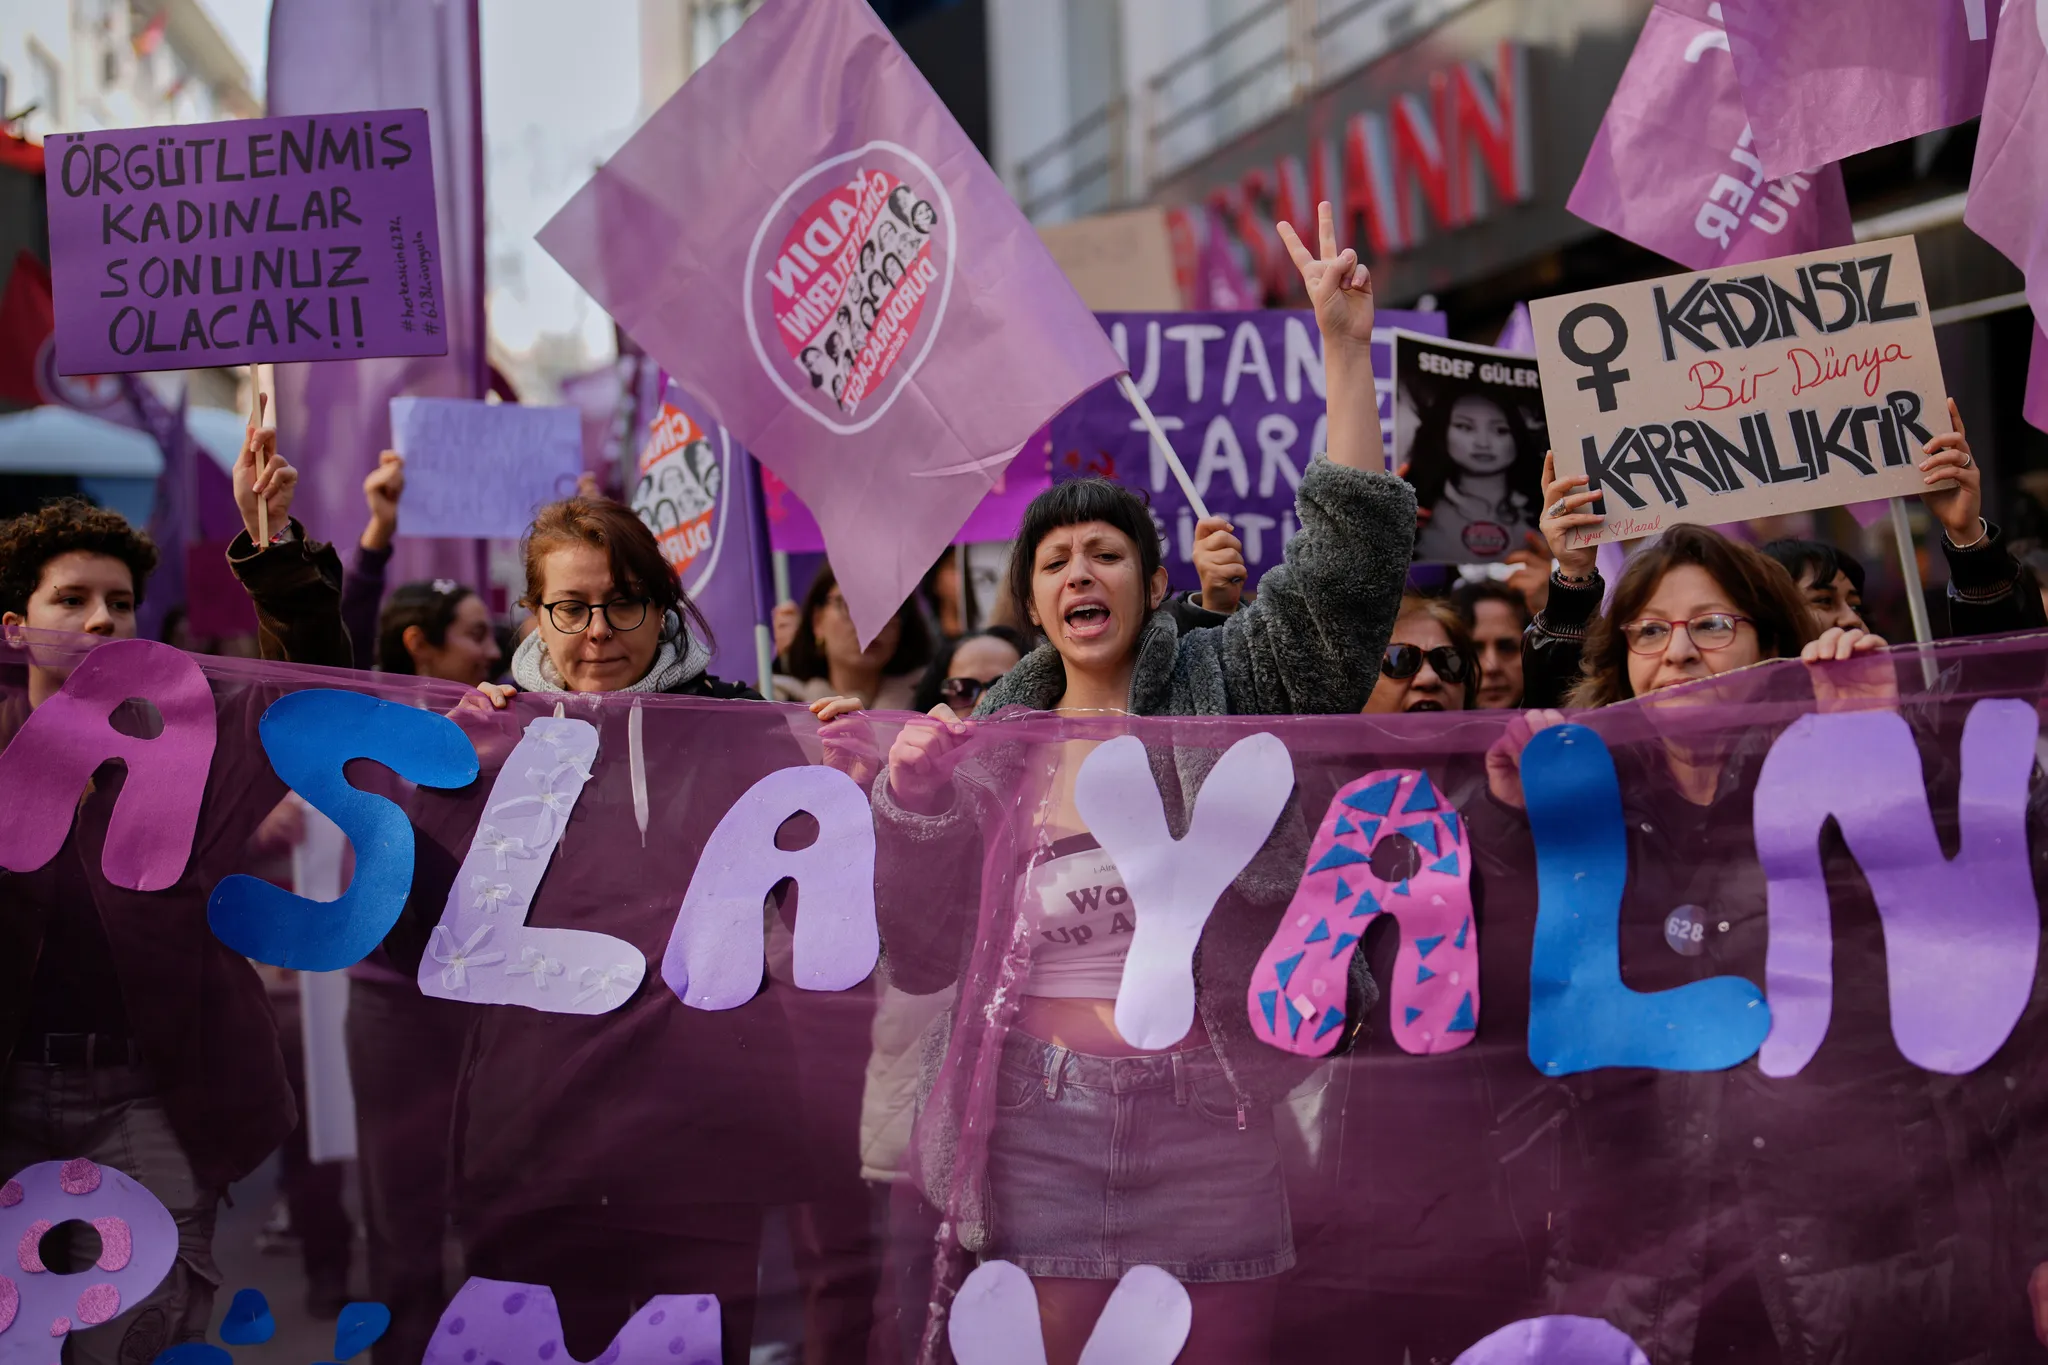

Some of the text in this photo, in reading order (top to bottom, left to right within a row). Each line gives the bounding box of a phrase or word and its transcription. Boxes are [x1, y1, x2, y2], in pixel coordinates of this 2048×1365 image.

[62, 119, 412, 197] ÖRGÜTLENMİŞ
[103, 186, 362, 244] KADINLAR
[100, 247, 369, 298] SONUNUZ
[109, 297, 365, 355] OLACAK!!
[1652, 254, 1920, 362] KADINSIZ
[1418, 352, 1539, 388] SEDEF GÜLER
[1685, 344, 1912, 411] Bir Dünya
[1130, 413, 1391, 497] TAR
[1582, 390, 1936, 515] KARANLIKTIR
[0, 638, 2041, 1079] ASLA YALN
[1041, 924, 1093, 946] Up
